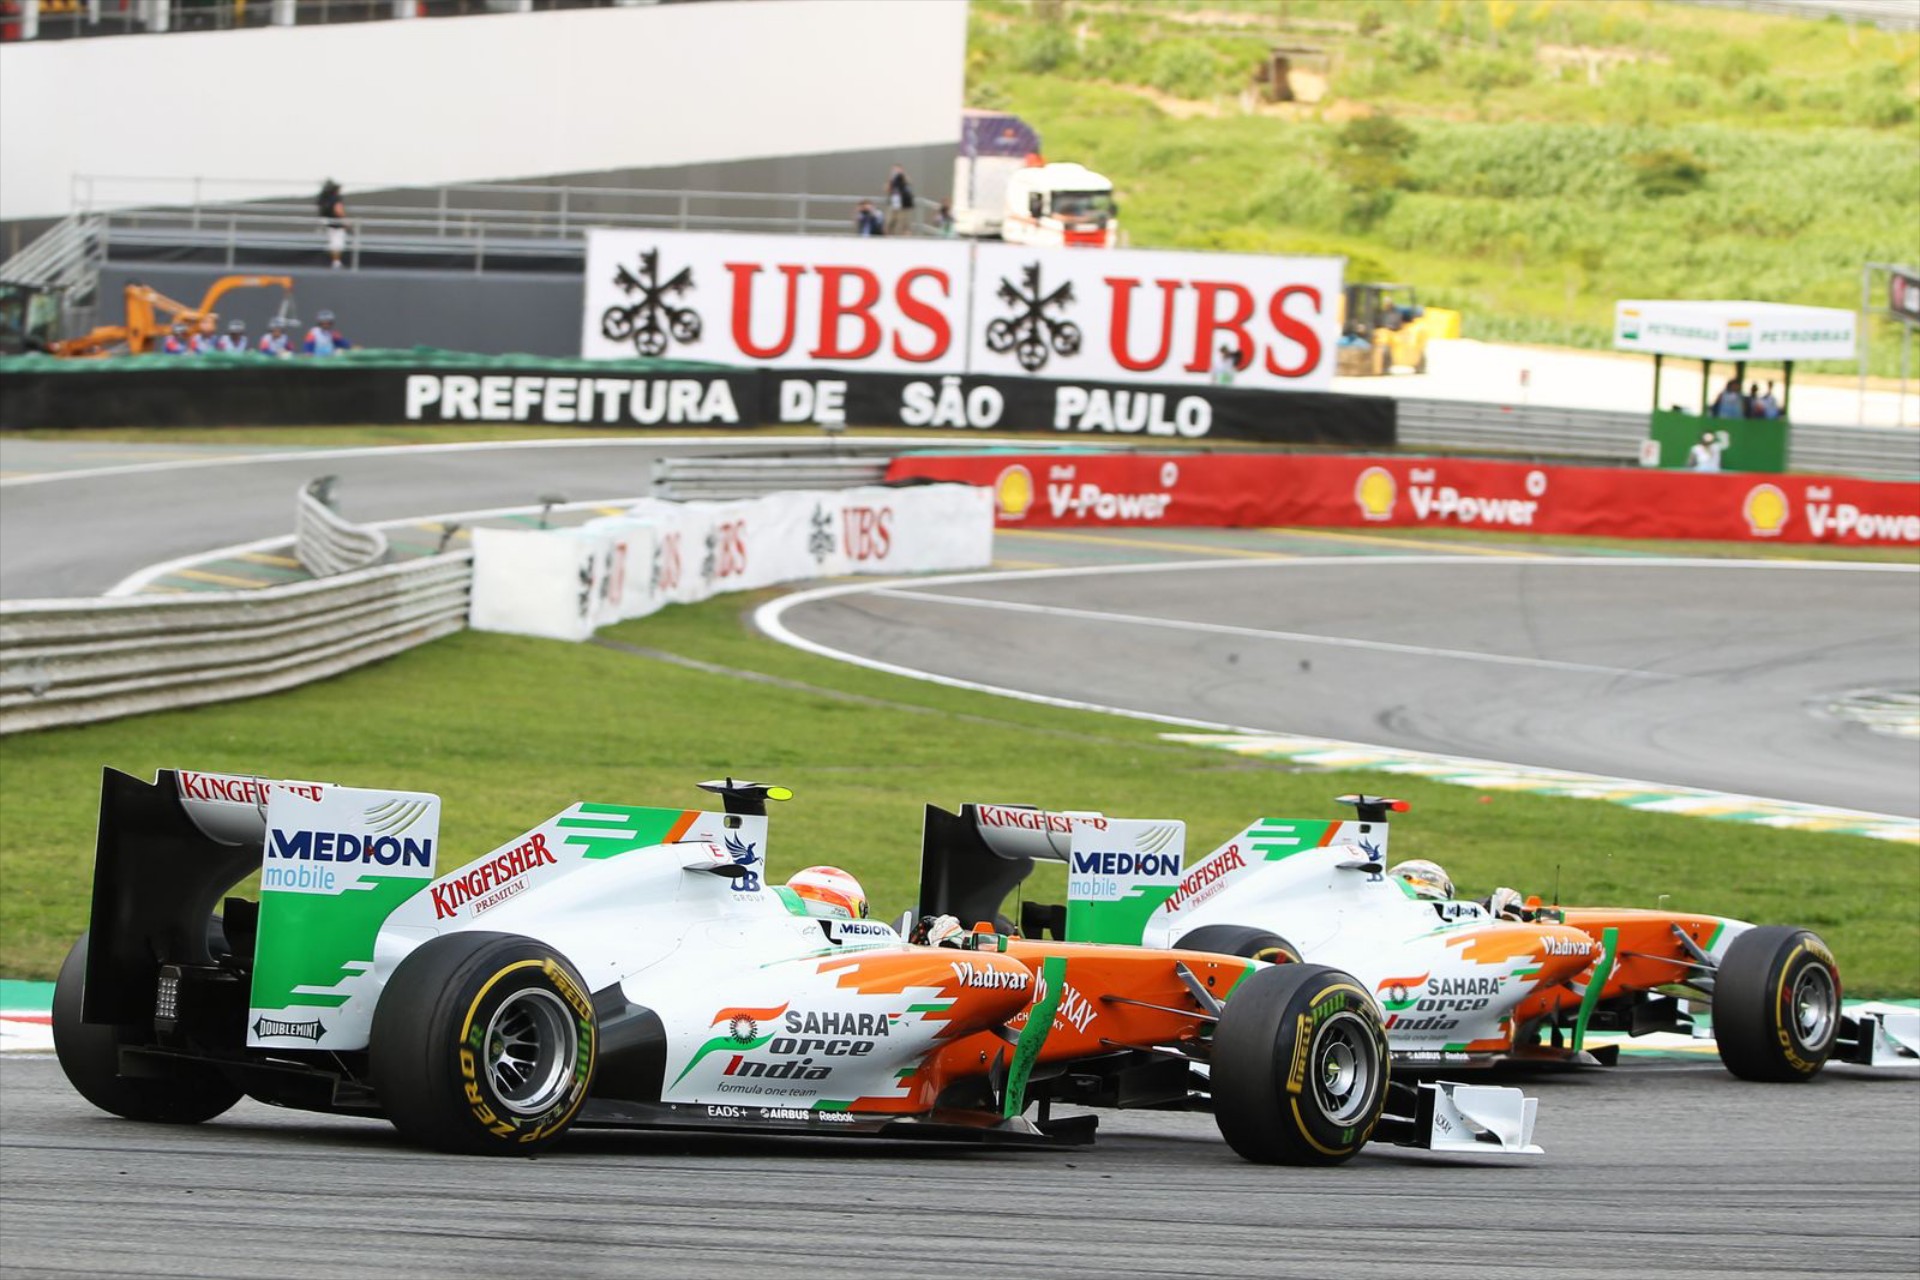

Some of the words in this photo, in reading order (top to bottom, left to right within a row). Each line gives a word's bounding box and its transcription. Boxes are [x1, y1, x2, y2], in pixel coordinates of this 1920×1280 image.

[724, 261, 951, 362] UBS
[1103, 276, 1321, 377] UBS
[405, 374, 739, 424] PREFEITURA
[780, 379, 847, 422] DE
[900, 377, 1003, 428] SÃO
[1054, 386, 1212, 437] PAULO
[1047, 483, 1171, 519] V-Power
[1409, 486, 1538, 525] V-Power
[842, 507, 892, 560] UBS
[1807, 503, 1920, 541] V-Powe
[181, 772, 323, 803] KINGFIER
[979, 806, 1108, 833] KINGFISHR
[268, 829, 432, 867] MEDION
[265, 865, 335, 890] mobile
[430, 832, 557, 920] KINGFISHER
[1072, 852, 1180, 877] MEDION
[475, 880, 525, 913] PREMIUM
[1071, 878, 1117, 896] mobile
[840, 923, 891, 936] MEDION
[1539, 936, 1592, 956] Vladivar
[951, 961, 1029, 990] Vladivar
[1427, 978, 1499, 996] SAHARA
[1033, 966, 1098, 1035] MCKAY
[260, 1020, 319, 1038] DOUBLEMINT
[785, 1010, 890, 1036] SAHARA
[1384, 1014, 1460, 1030] India
[723, 1055, 832, 1080] India
[459, 1049, 517, 1139] ZERO
[717, 1081, 762, 1096] formula
[764, 1087, 787, 1096] one
[789, 1086, 817, 1097] team
[770, 1108, 810, 1120] AIRBUS
[818, 1110, 854, 1122] Reebok
